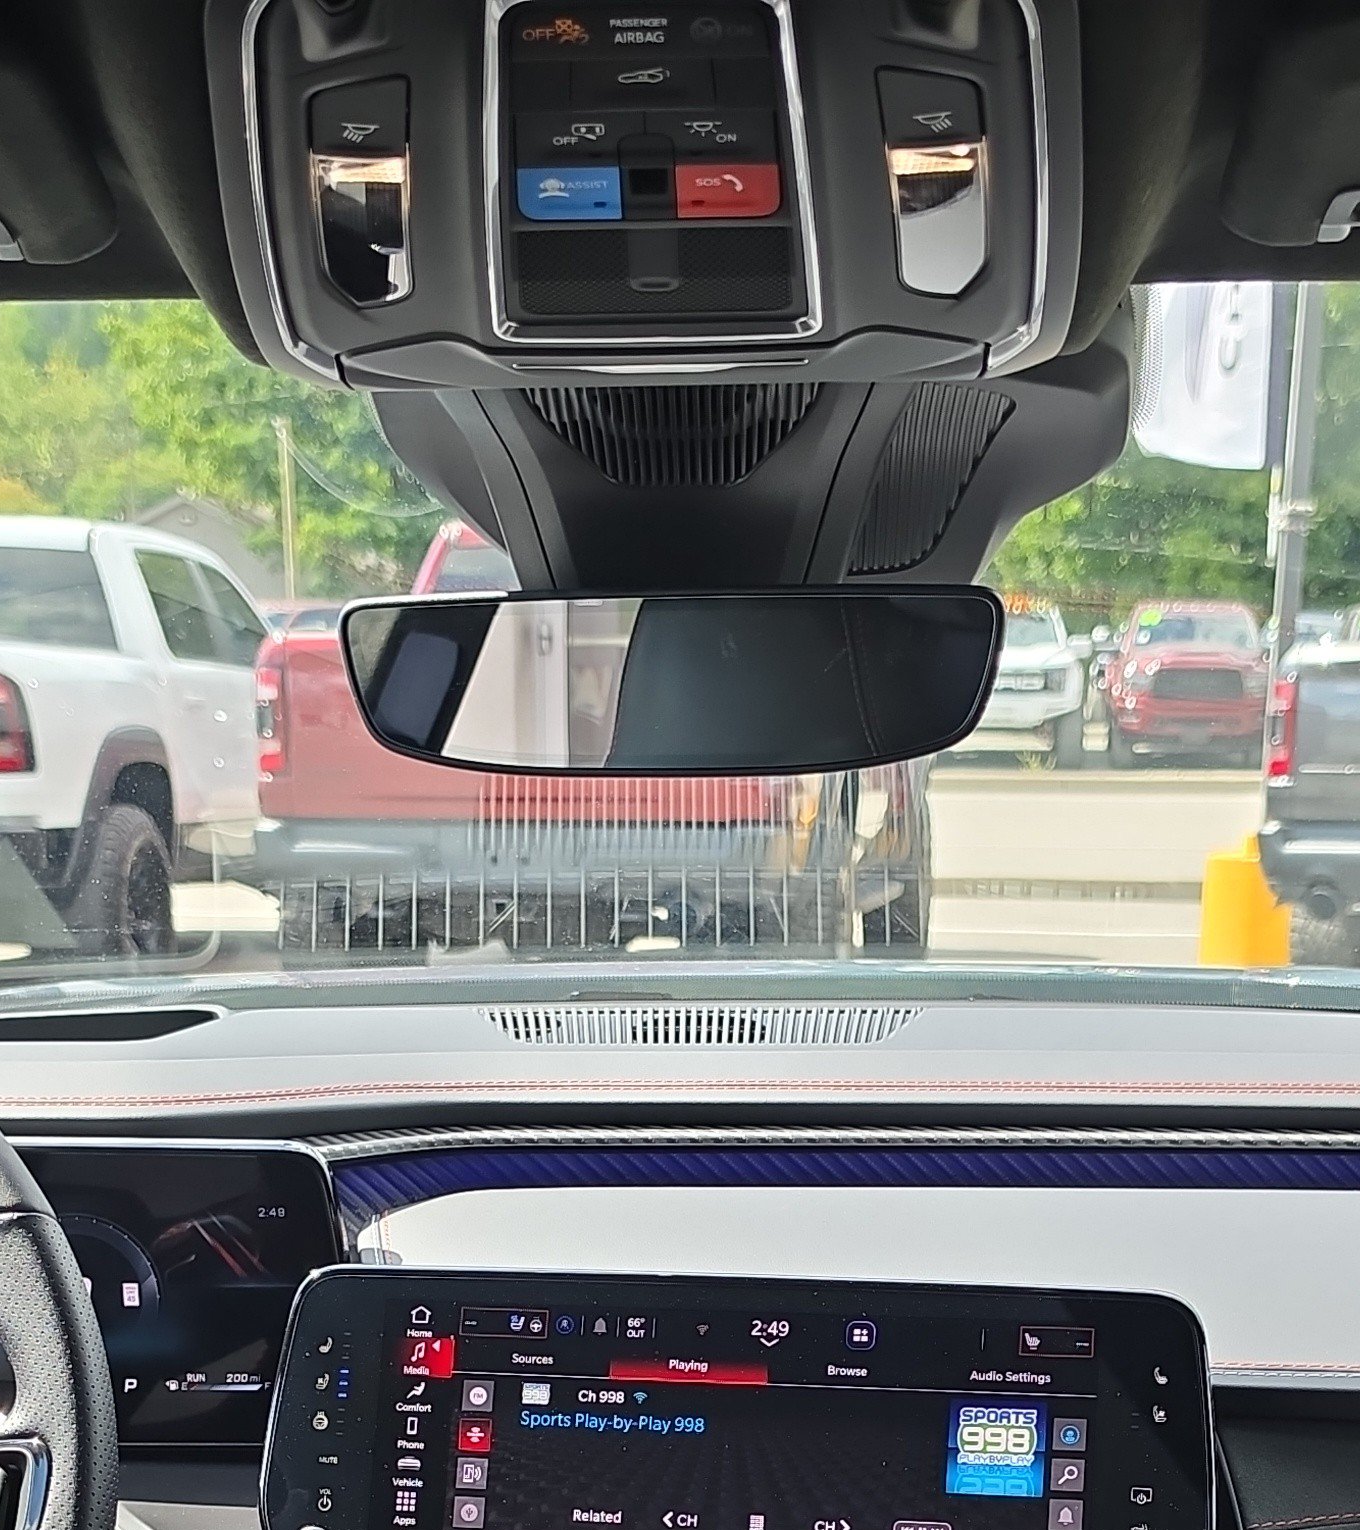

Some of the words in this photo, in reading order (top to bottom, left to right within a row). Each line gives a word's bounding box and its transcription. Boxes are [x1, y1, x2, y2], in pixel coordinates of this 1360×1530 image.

[609, 18, 667, 28] PASSENGER
[522, 29, 554, 41] OFF
[614, 32, 665, 44] AIRBAG
[553, 137, 578, 146] OFF
[716, 134, 737, 143] ON
[567, 181, 608, 189] ASSIST
[695, 178, 722, 187] SOS
[627, 1317, 646, 1328] 66°
[406, 1328, 433, 1338] Home
[626, 1328, 646, 1338] OUT
[750, 1320, 790, 1337] 2:49
[511, 1353, 554, 1365] Sources
[403, 1365, 430, 1375] Media
[669, 1359, 709, 1373] Playing
[827, 1365, 868, 1377] Browse
[186, 1373, 206, 1383] RUN
[225, 1374, 248, 1383] 200
[250, 1374, 261, 1383] mi
[970, 1370, 1004, 1383] Audio
[1006, 1371, 1051, 1385] Settings
[124, 1378, 138, 1393] P
[181, 1382, 188, 1390] E
[264, 1382, 272, 1390] F
[578, 1389, 597, 1403] Ch
[599, 1390, 625, 1404] 998
[396, 1402, 431, 1413] Comfort
[520, 1411, 571, 1429] Sports
[575, 1412, 671, 1433] Play-by-Play
[674, 1417, 705, 1433] 998
[961, 1409, 1036, 1424] SPORTS
[397, 1439, 425, 1449] Phone
[962, 1426, 1031, 1453] 998
[319, 1456, 338, 1464] MUTE
[392, 1477, 424, 1488] Vehicle
[393, 1515, 416, 1527] Apps
[572, 1508, 622, 1524] Related
[677, 1514, 698, 1528] CH
